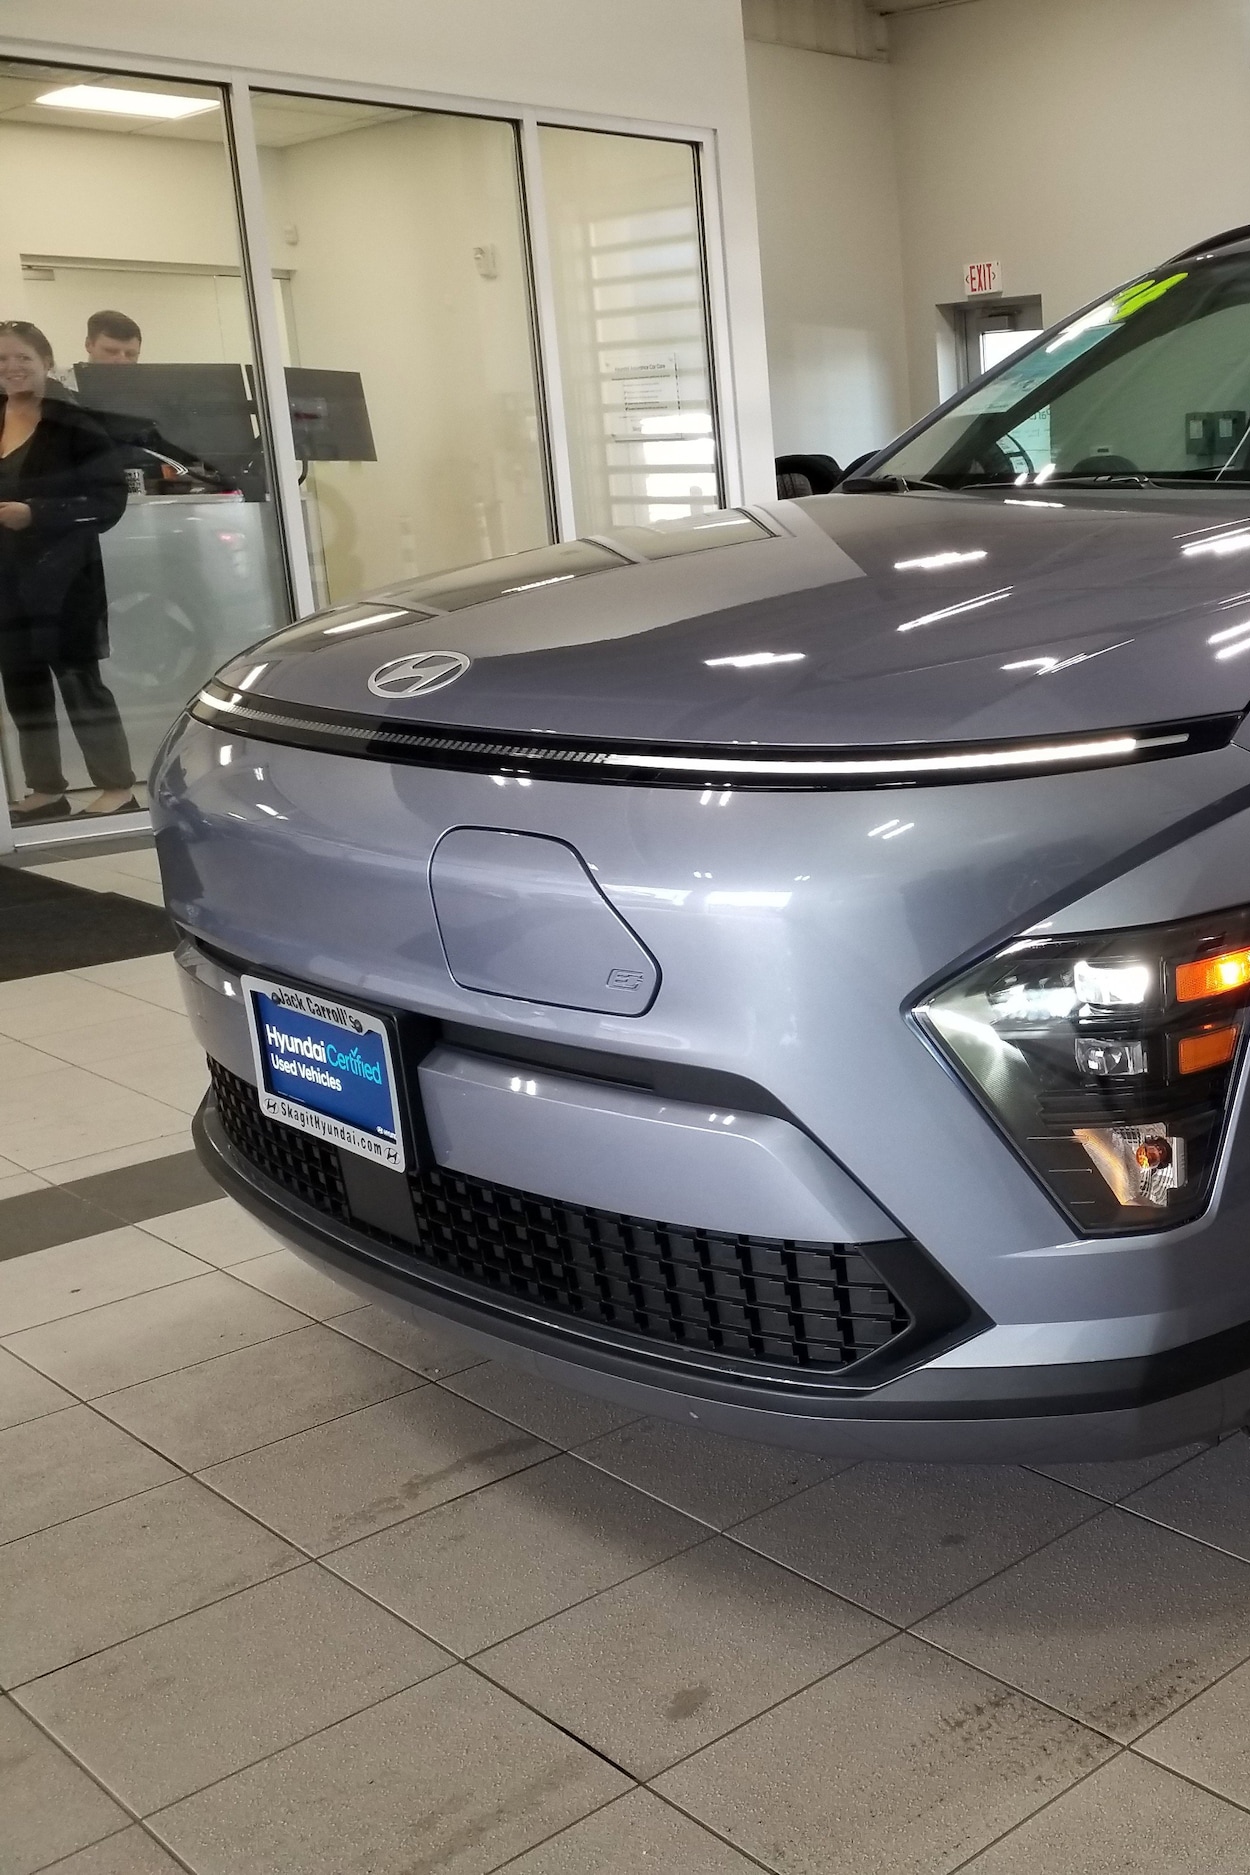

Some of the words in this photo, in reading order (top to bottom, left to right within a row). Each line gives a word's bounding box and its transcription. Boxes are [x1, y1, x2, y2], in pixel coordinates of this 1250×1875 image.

[969, 263, 992, 292] EXIT
[278, 987, 304, 1011] Jack
[307, 999, 356, 1030] Carroll's
[271, 1053, 298, 1077] Used
[298, 1062, 342, 1092] Vehicles
[280, 1101, 383, 1157] SkagitHyundai.com
